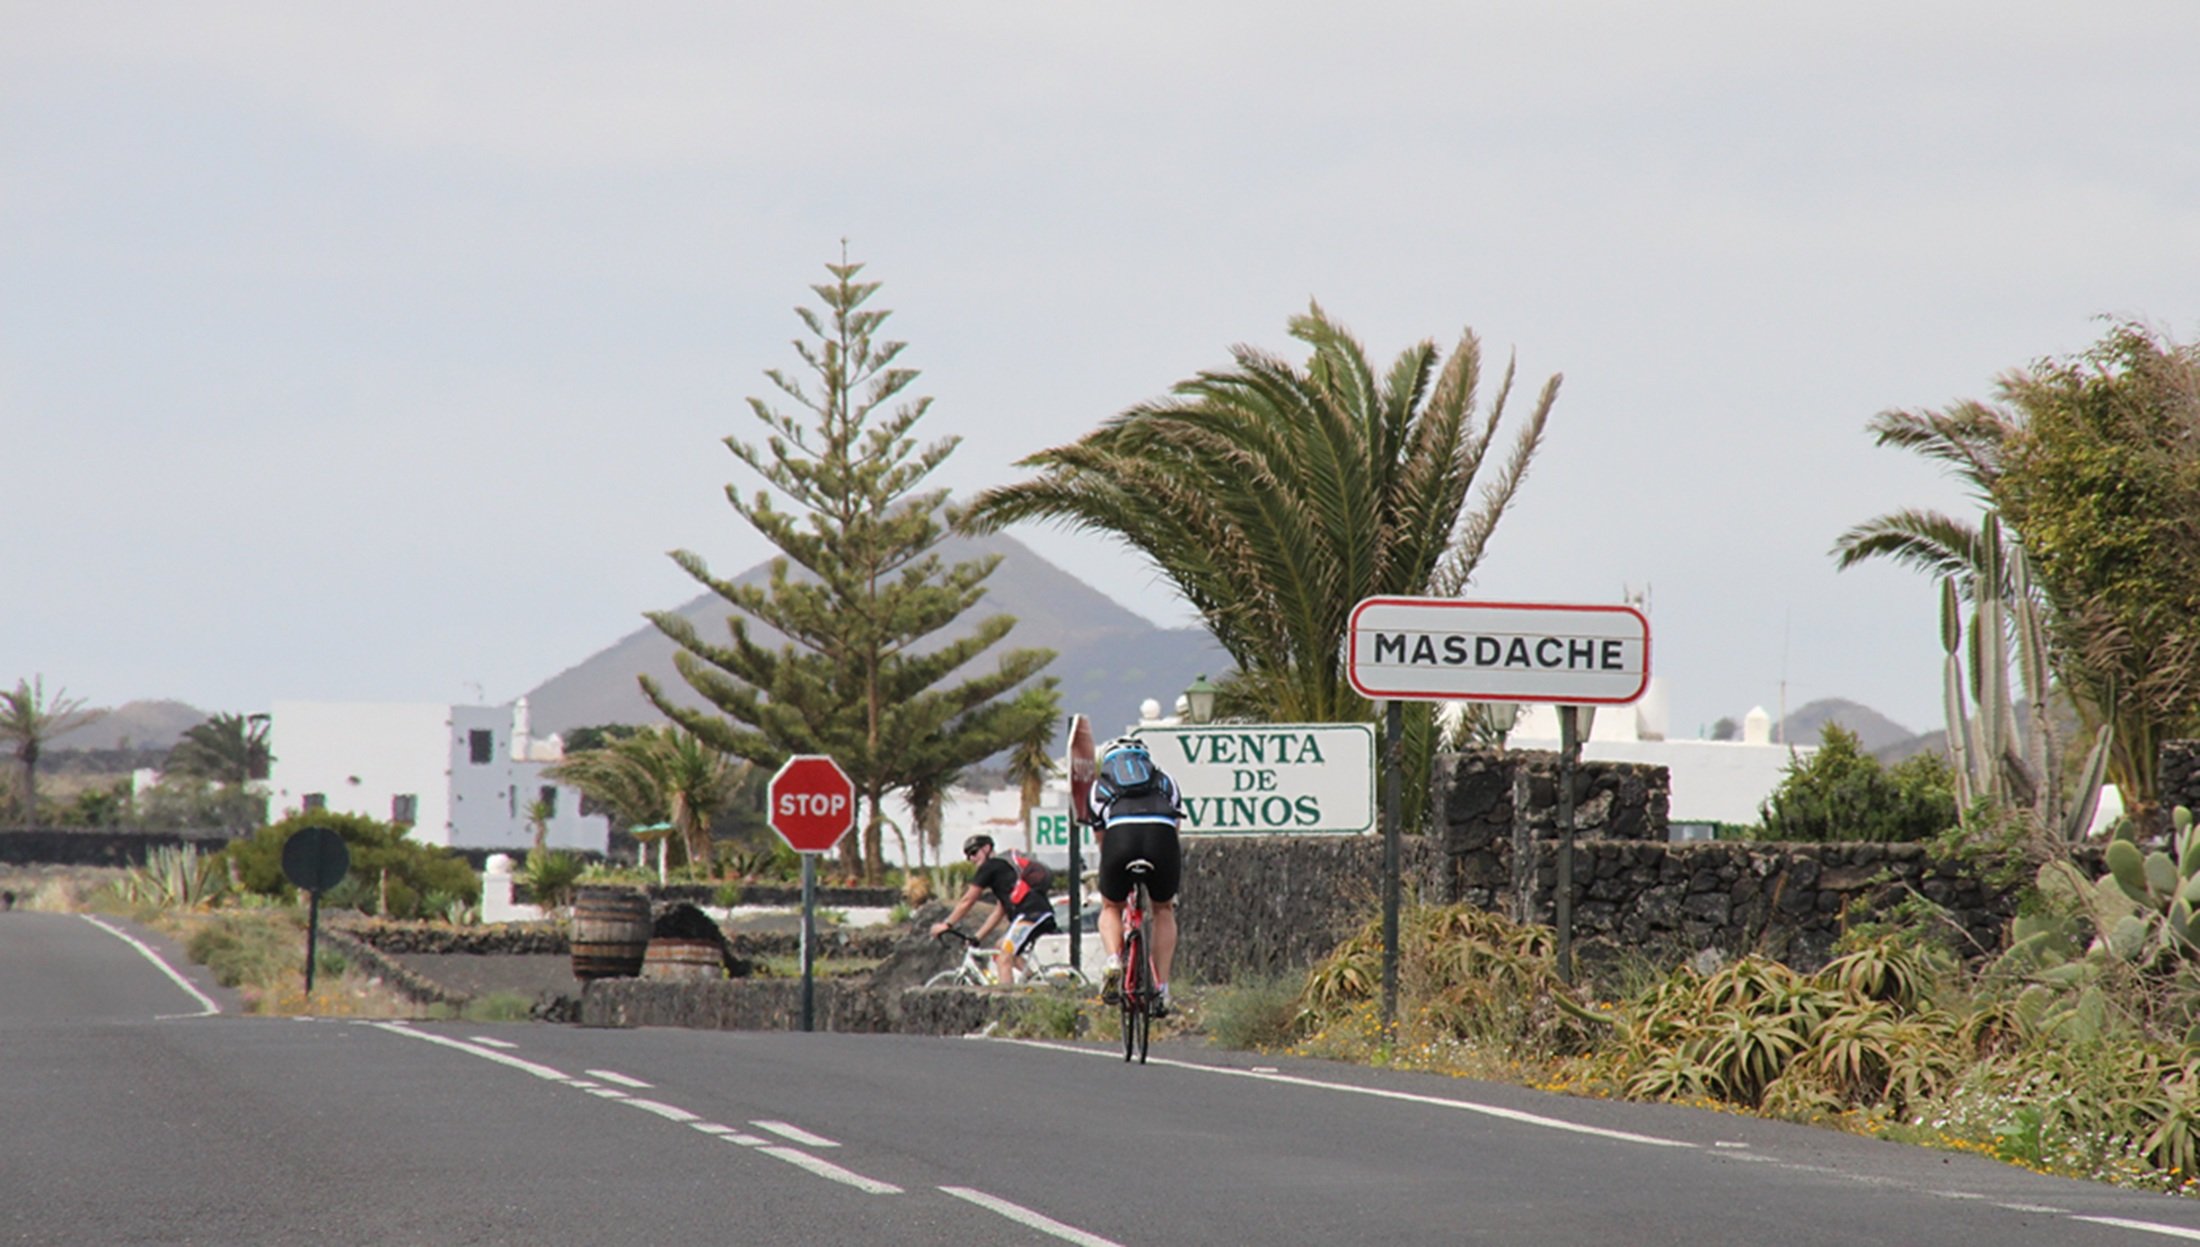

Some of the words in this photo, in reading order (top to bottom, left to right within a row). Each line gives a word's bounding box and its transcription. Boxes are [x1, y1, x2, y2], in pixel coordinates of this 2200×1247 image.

[1374, 632, 1624, 670] MASDACHE
[1177, 733, 1325, 764] VENTA
[1233, 769, 1278, 792] DE
[779, 793, 846, 817] STOP
[1182, 795, 1321, 827] VINOS
